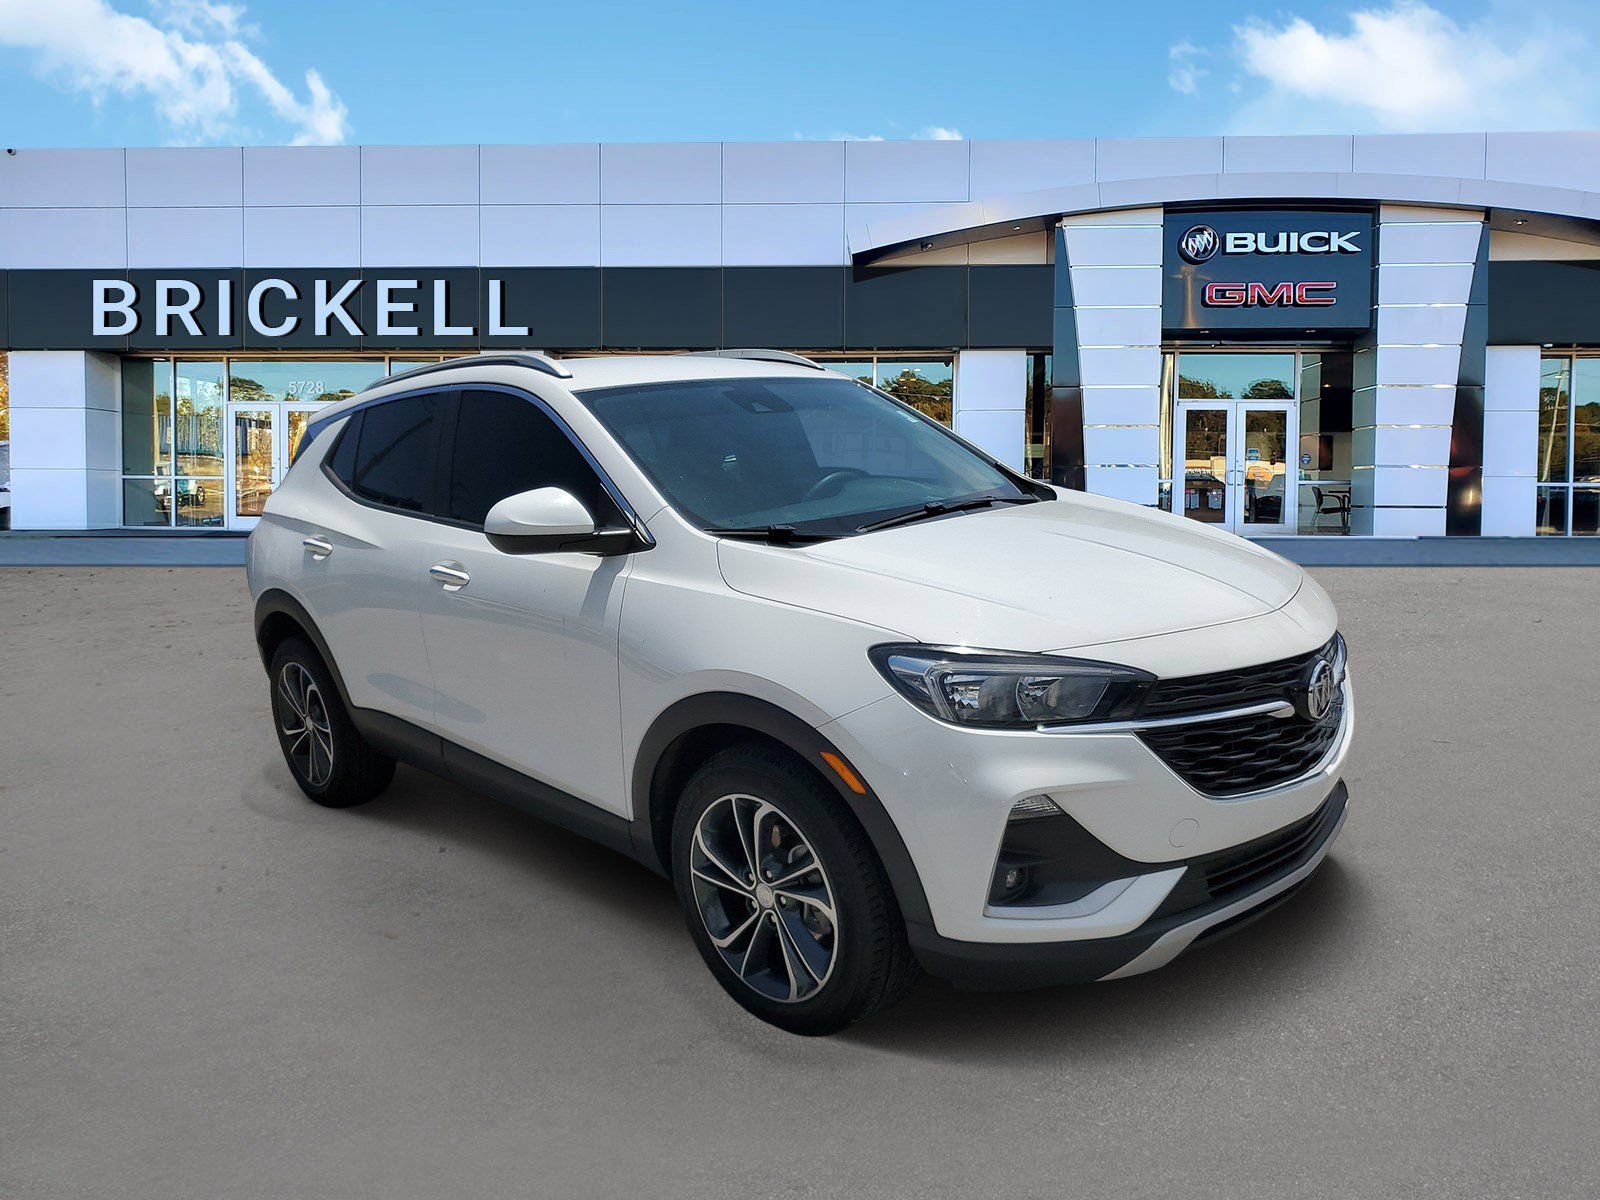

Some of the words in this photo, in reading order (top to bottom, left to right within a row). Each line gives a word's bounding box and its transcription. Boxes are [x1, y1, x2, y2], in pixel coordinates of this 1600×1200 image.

[1225, 231, 1362, 253] BUICK
[1204, 281, 1338, 306] GMC
[92, 278, 530, 337] BRICKELL
[288, 380, 325, 394] 5728
